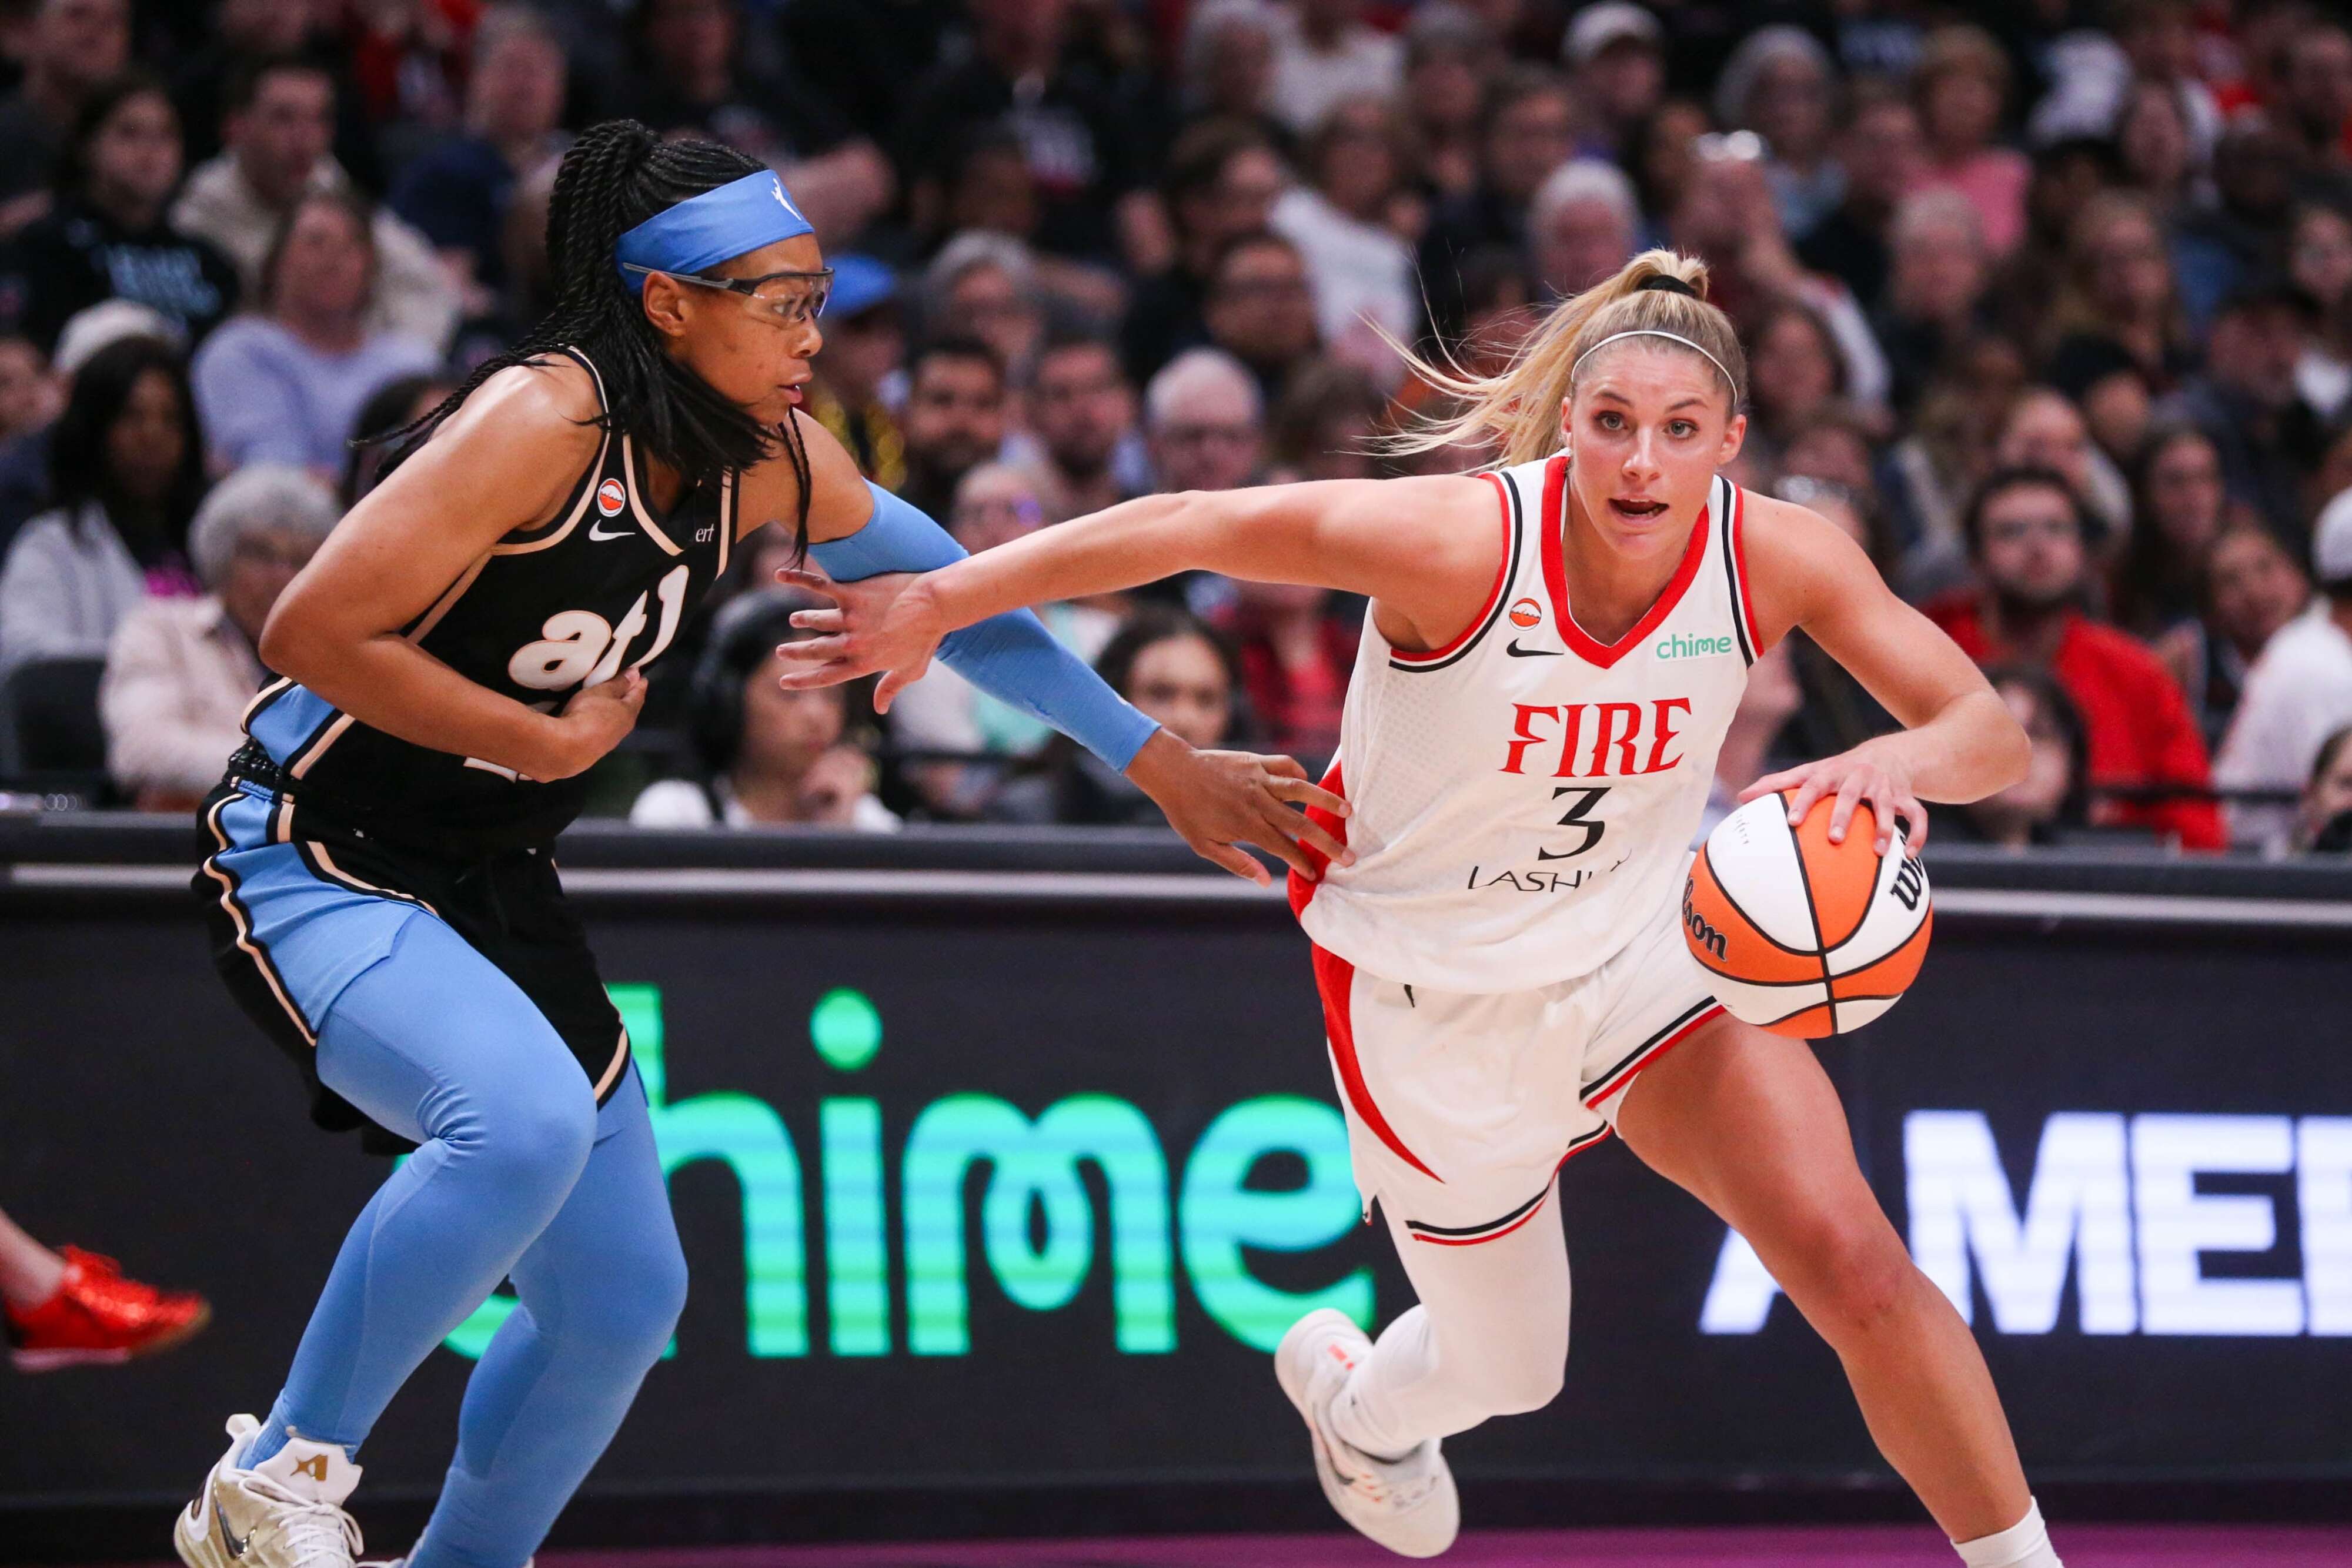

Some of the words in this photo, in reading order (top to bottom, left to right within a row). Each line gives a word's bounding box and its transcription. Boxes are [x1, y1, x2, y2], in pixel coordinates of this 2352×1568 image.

[1656, 633, 1732, 659] chime
[1498, 697, 1692, 778] FIRE
[1538, 787, 1612, 861] 3
[1682, 877, 1728, 963] lson
[392, 982, 1376, 1358] hime
[1698, 1109, 2352, 1336] ME
